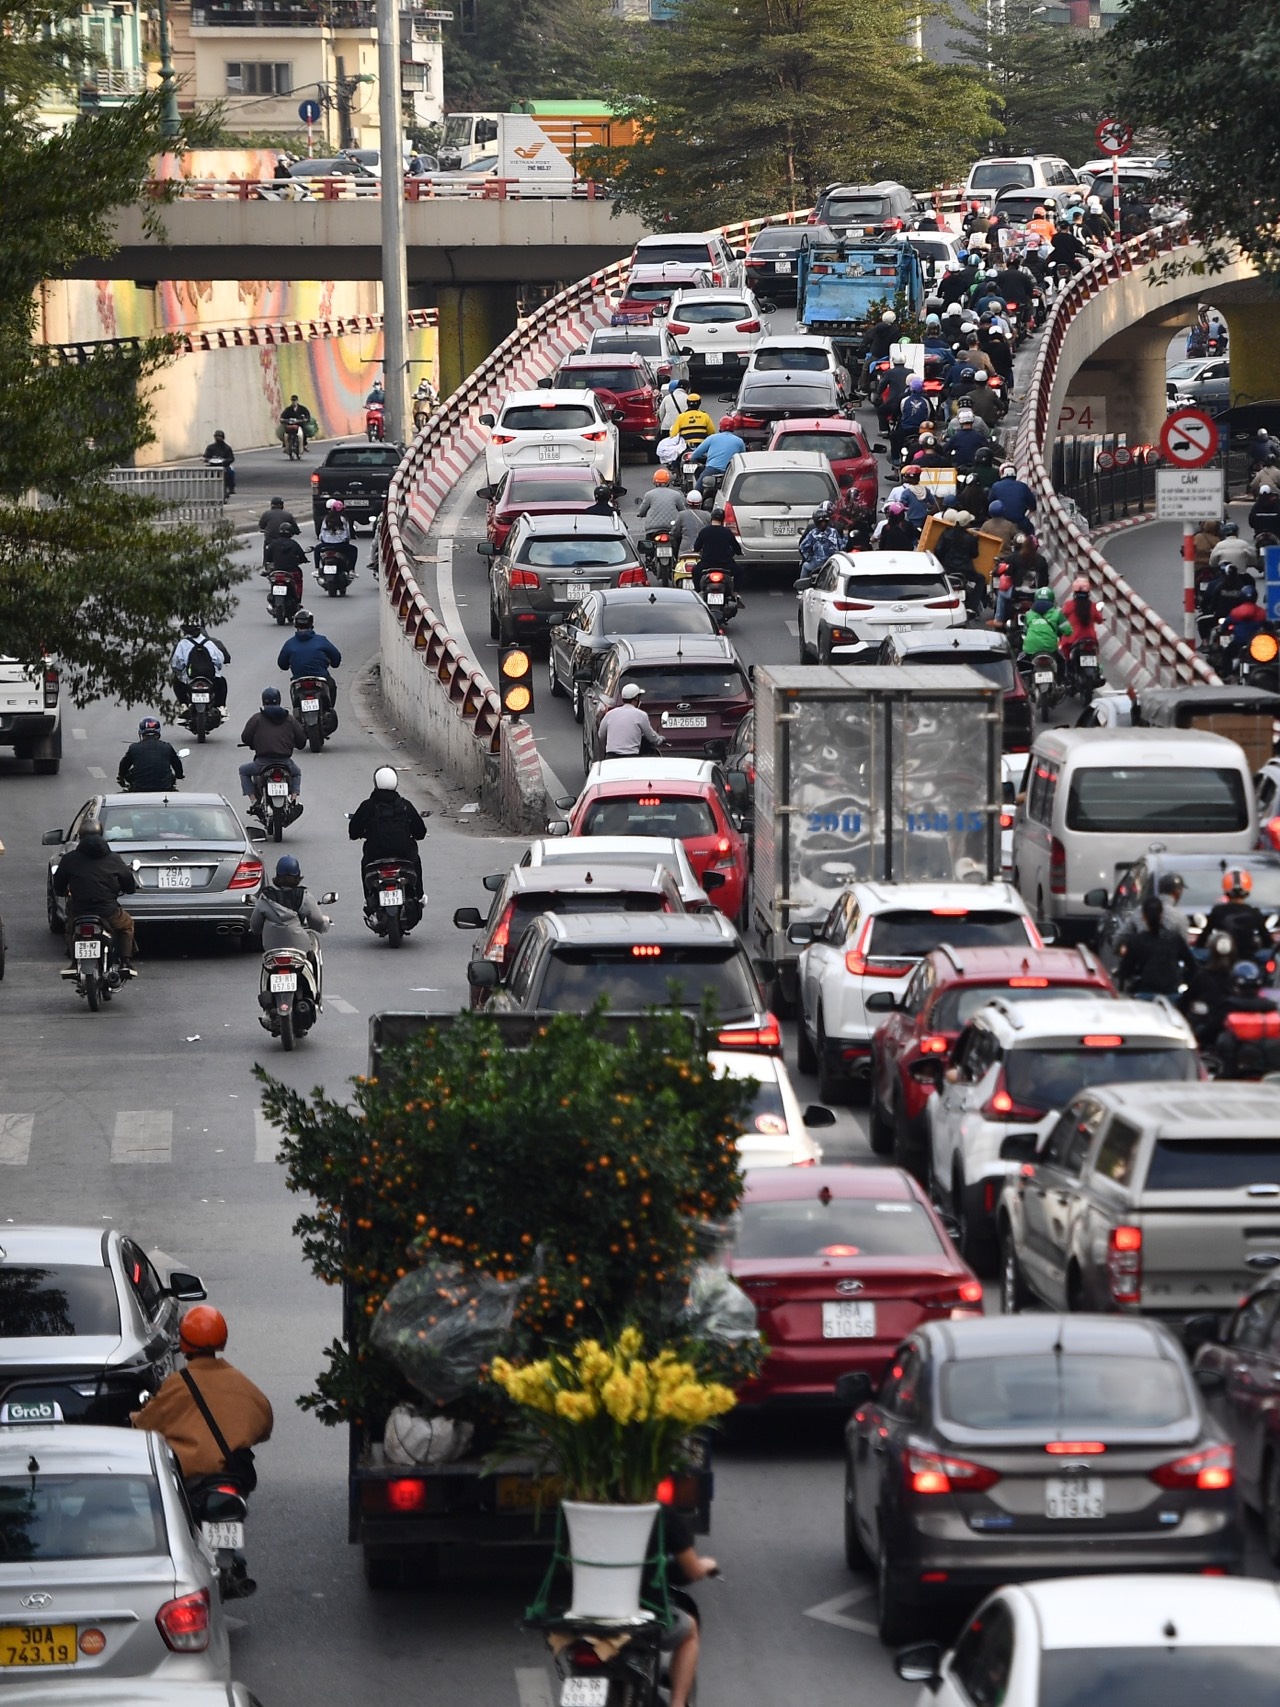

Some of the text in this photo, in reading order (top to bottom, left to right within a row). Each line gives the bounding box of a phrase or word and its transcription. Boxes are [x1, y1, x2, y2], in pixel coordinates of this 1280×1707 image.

[1057, 405, 1094, 430] P4
[1181, 471, 1198, 485] CẤM
[573, 584, 584, 592] 29A
[666, 717, 705, 727] 9A-265.55
[165, 867, 183, 877] 29A
[160, 876, 191, 887] 115.42
[835, 1302, 861, 1319] 36A
[11, 1403, 52, 1418] Grab
[20, 1627, 54, 1645] 30A
[6, 1645, 69, 1664] 743.19
